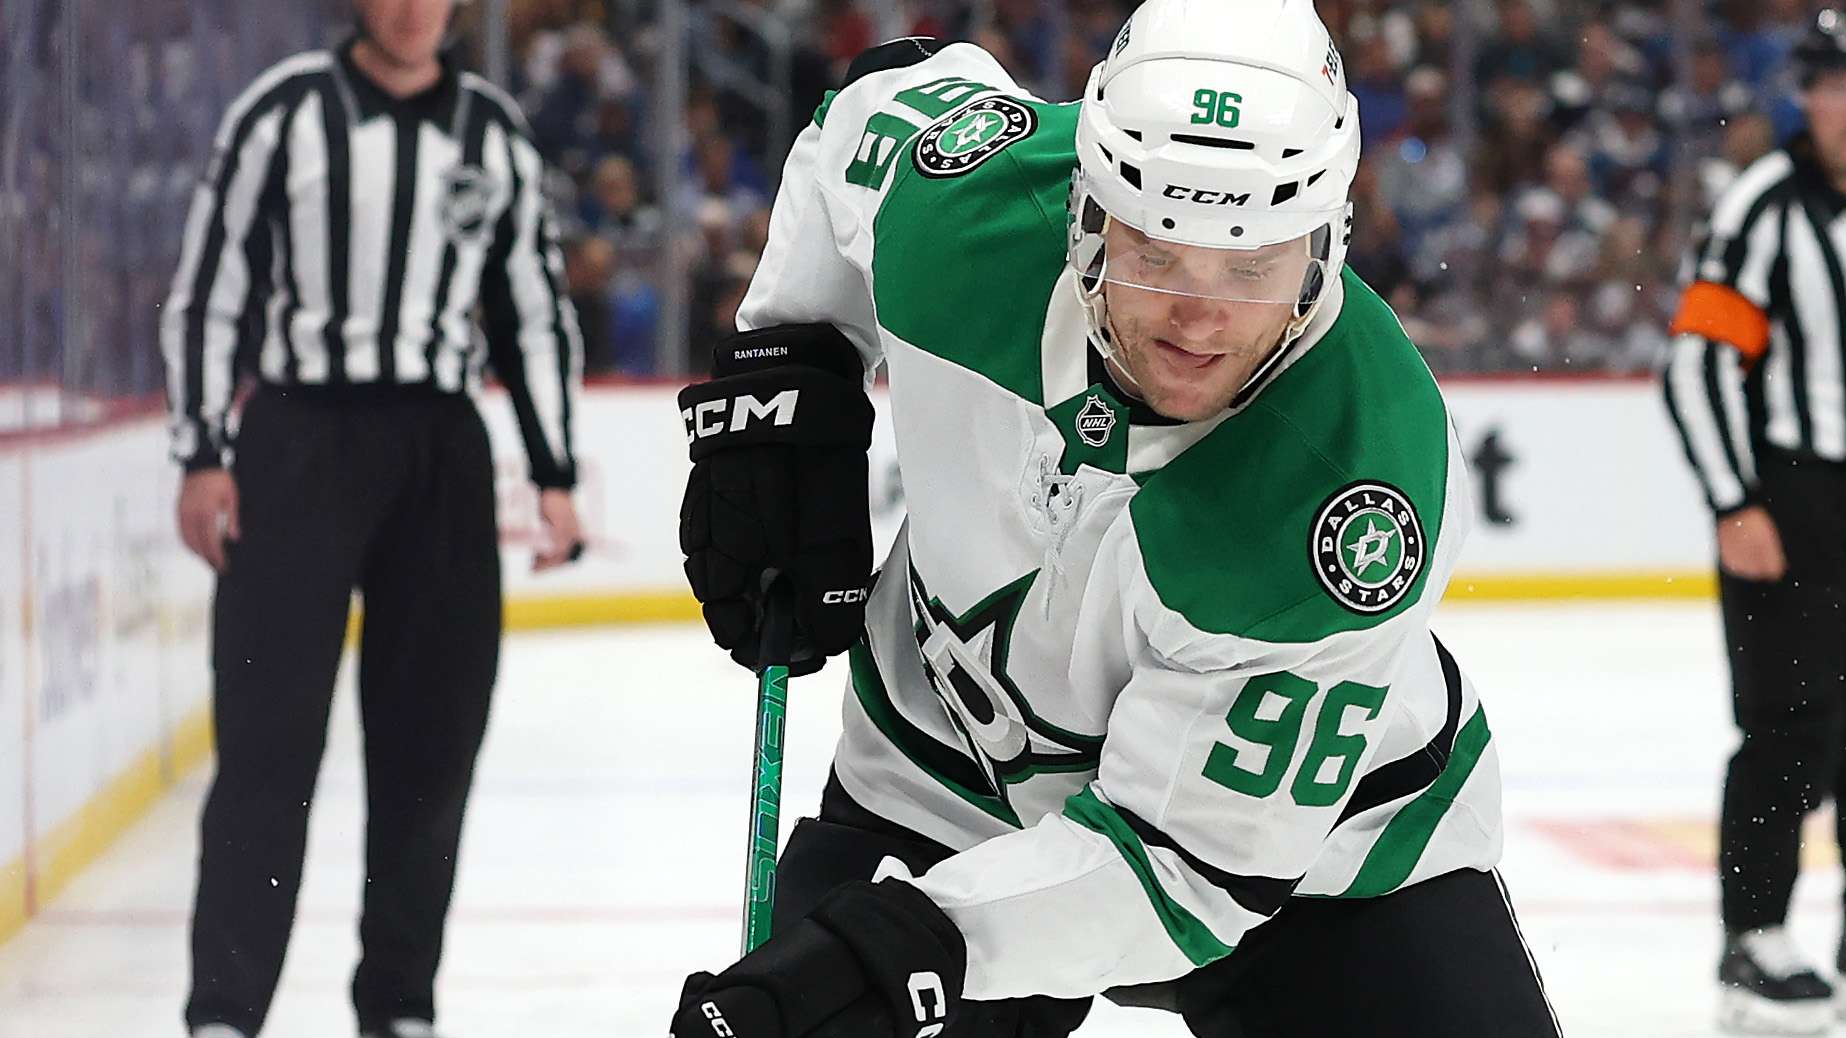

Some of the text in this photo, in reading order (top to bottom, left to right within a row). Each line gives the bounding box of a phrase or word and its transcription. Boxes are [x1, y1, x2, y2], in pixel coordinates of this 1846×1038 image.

[1190, 88, 1243, 129] 96
[1162, 183, 1252, 207] CCM
[734, 346, 788, 359] RANTANEN
[1082, 418, 1108, 428] NHL
[1321, 493, 1410, 554] DALLAS
[1338, 555, 1416, 602] STARS
[1201, 671, 1391, 807] 96
